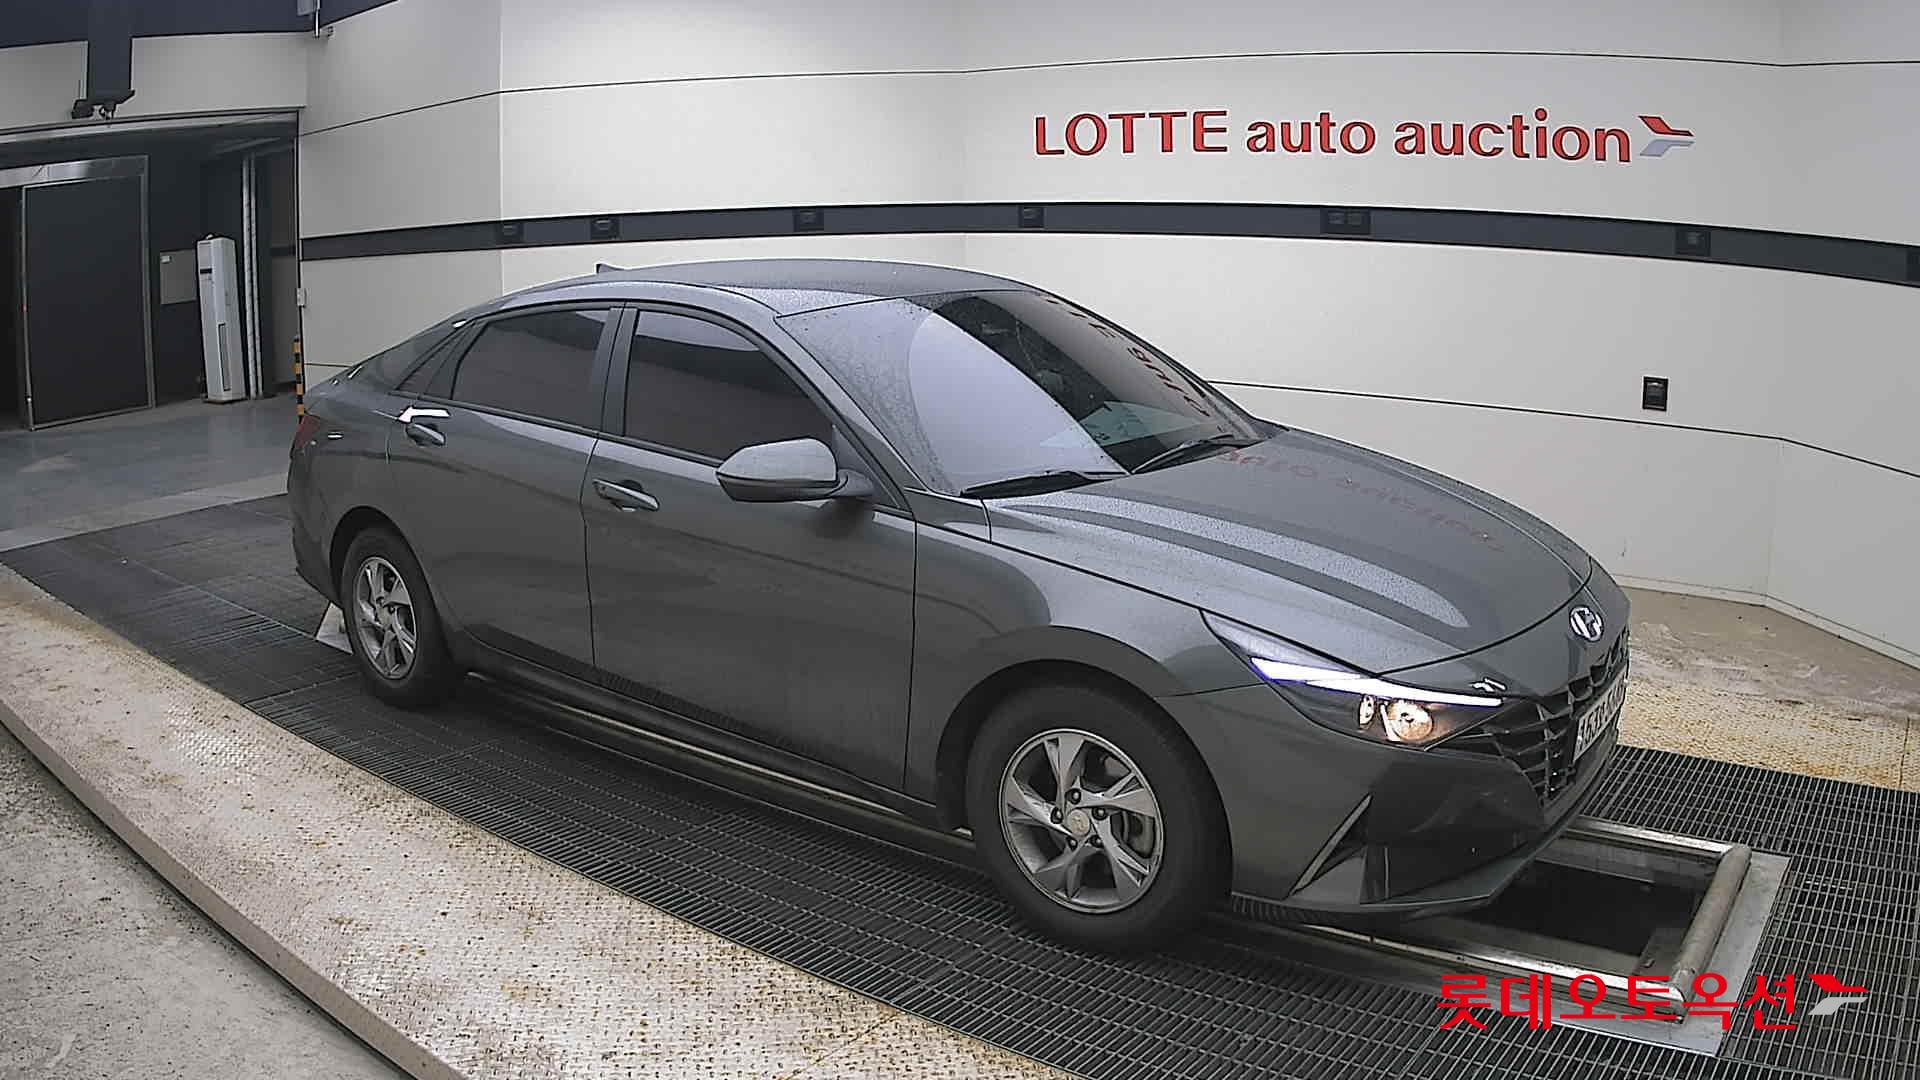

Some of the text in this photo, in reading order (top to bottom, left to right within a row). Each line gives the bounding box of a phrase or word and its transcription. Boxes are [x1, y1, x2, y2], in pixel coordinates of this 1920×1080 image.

[1034, 107, 1631, 162] LOTTE auto auction
